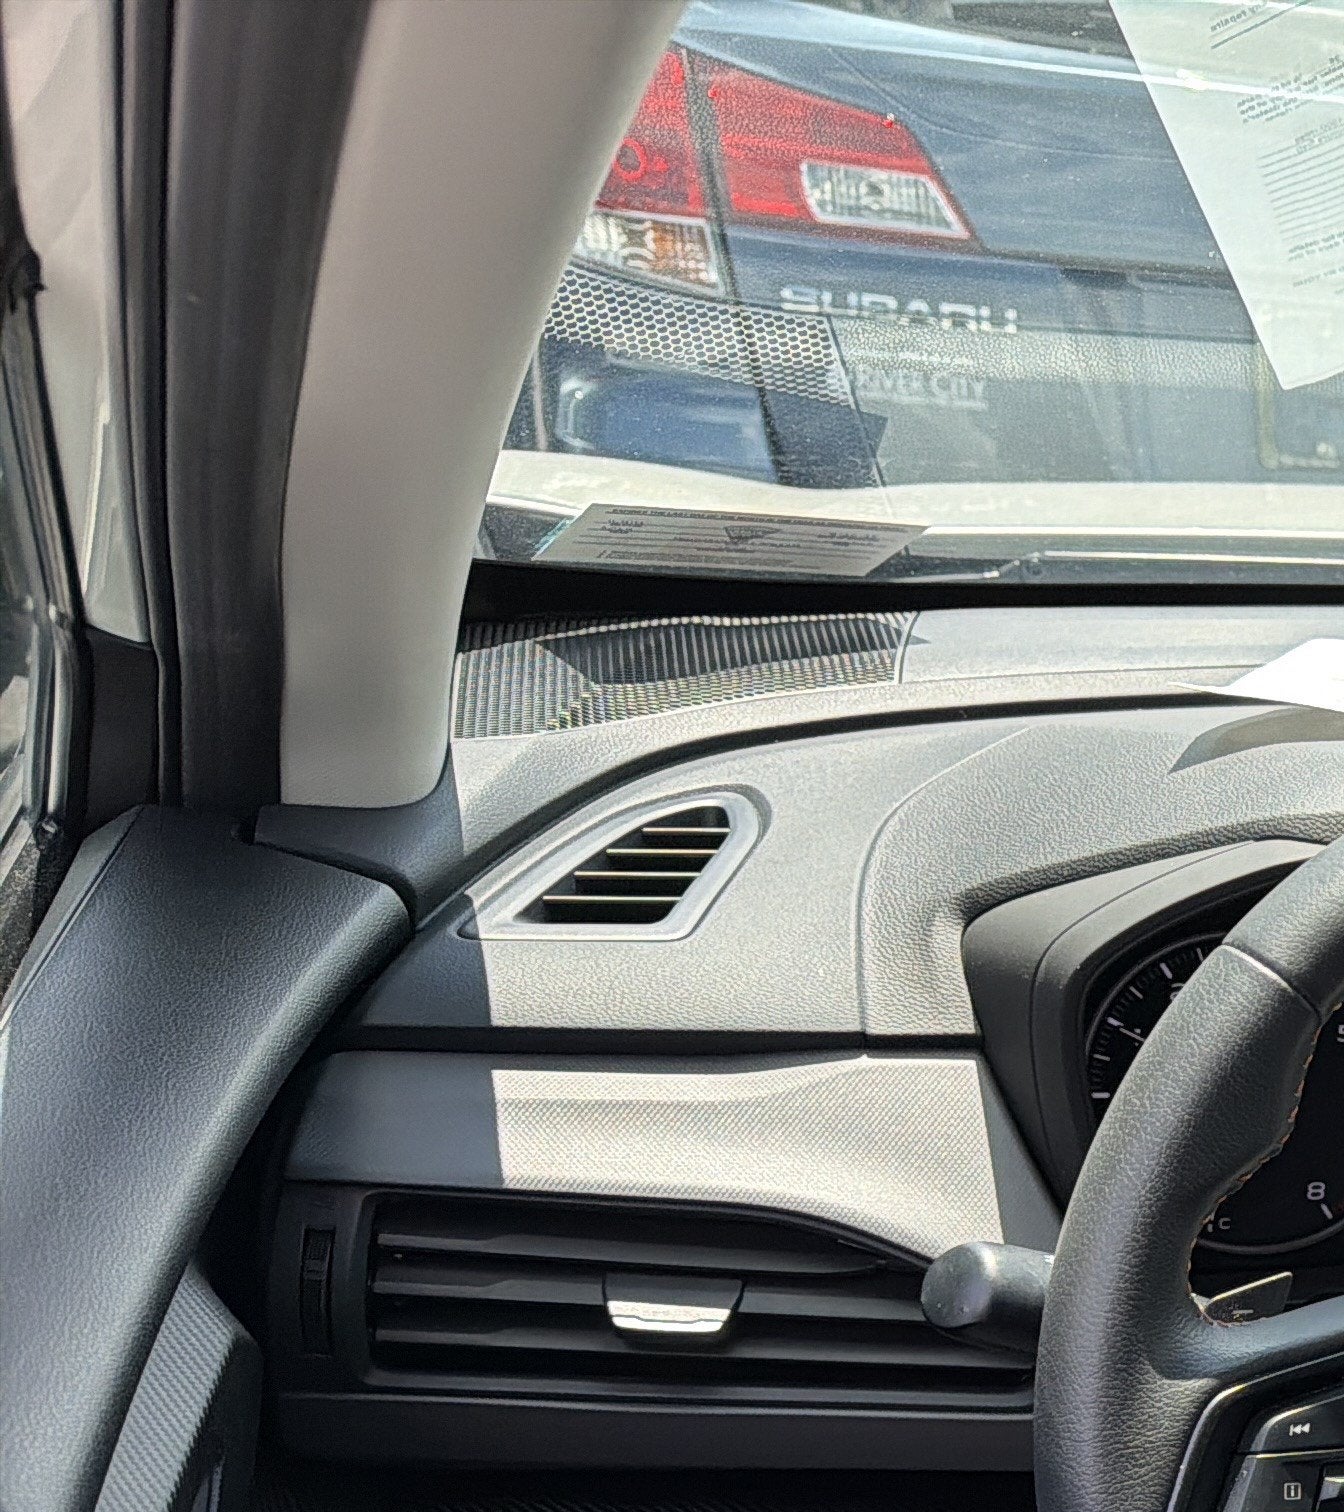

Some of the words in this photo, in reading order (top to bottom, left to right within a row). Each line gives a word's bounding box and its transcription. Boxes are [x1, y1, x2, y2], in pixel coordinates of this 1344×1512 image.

[780, 284, 1017, 334] SUBARU
[1306, 1181, 1326, 1200] 8
[1218, 1217, 1231, 1230] C
